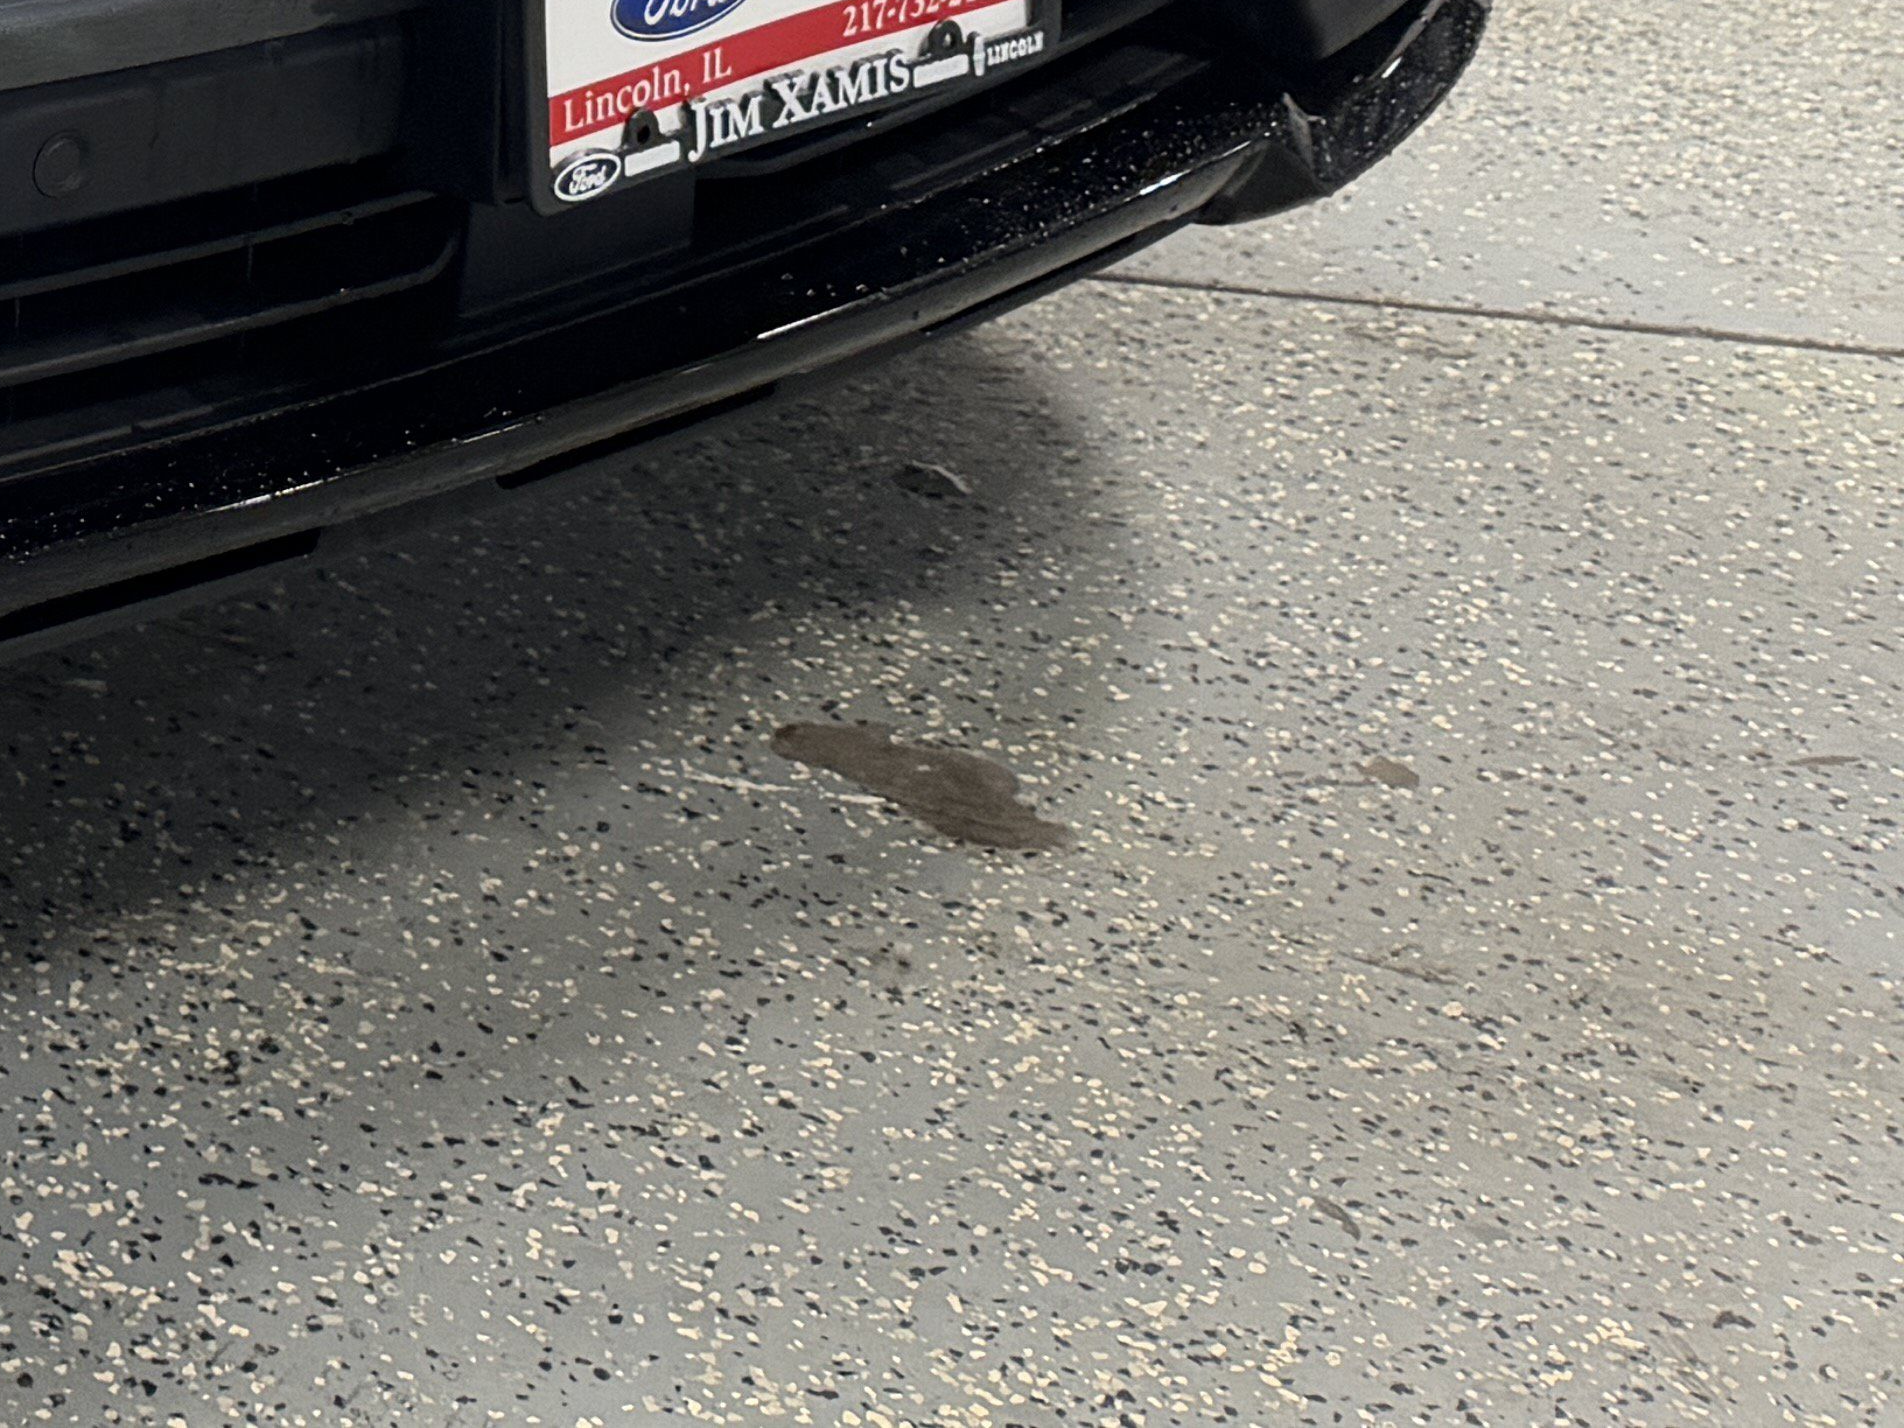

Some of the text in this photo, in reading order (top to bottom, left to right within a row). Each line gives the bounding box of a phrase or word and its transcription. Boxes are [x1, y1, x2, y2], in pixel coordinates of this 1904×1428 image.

[987, 30, 1044, 67] LINCOLN
[563, 48, 733, 134] Lincoln, IL
[688, 55, 911, 162] JIM XAMIS
[568, 163, 608, 196] Ford
